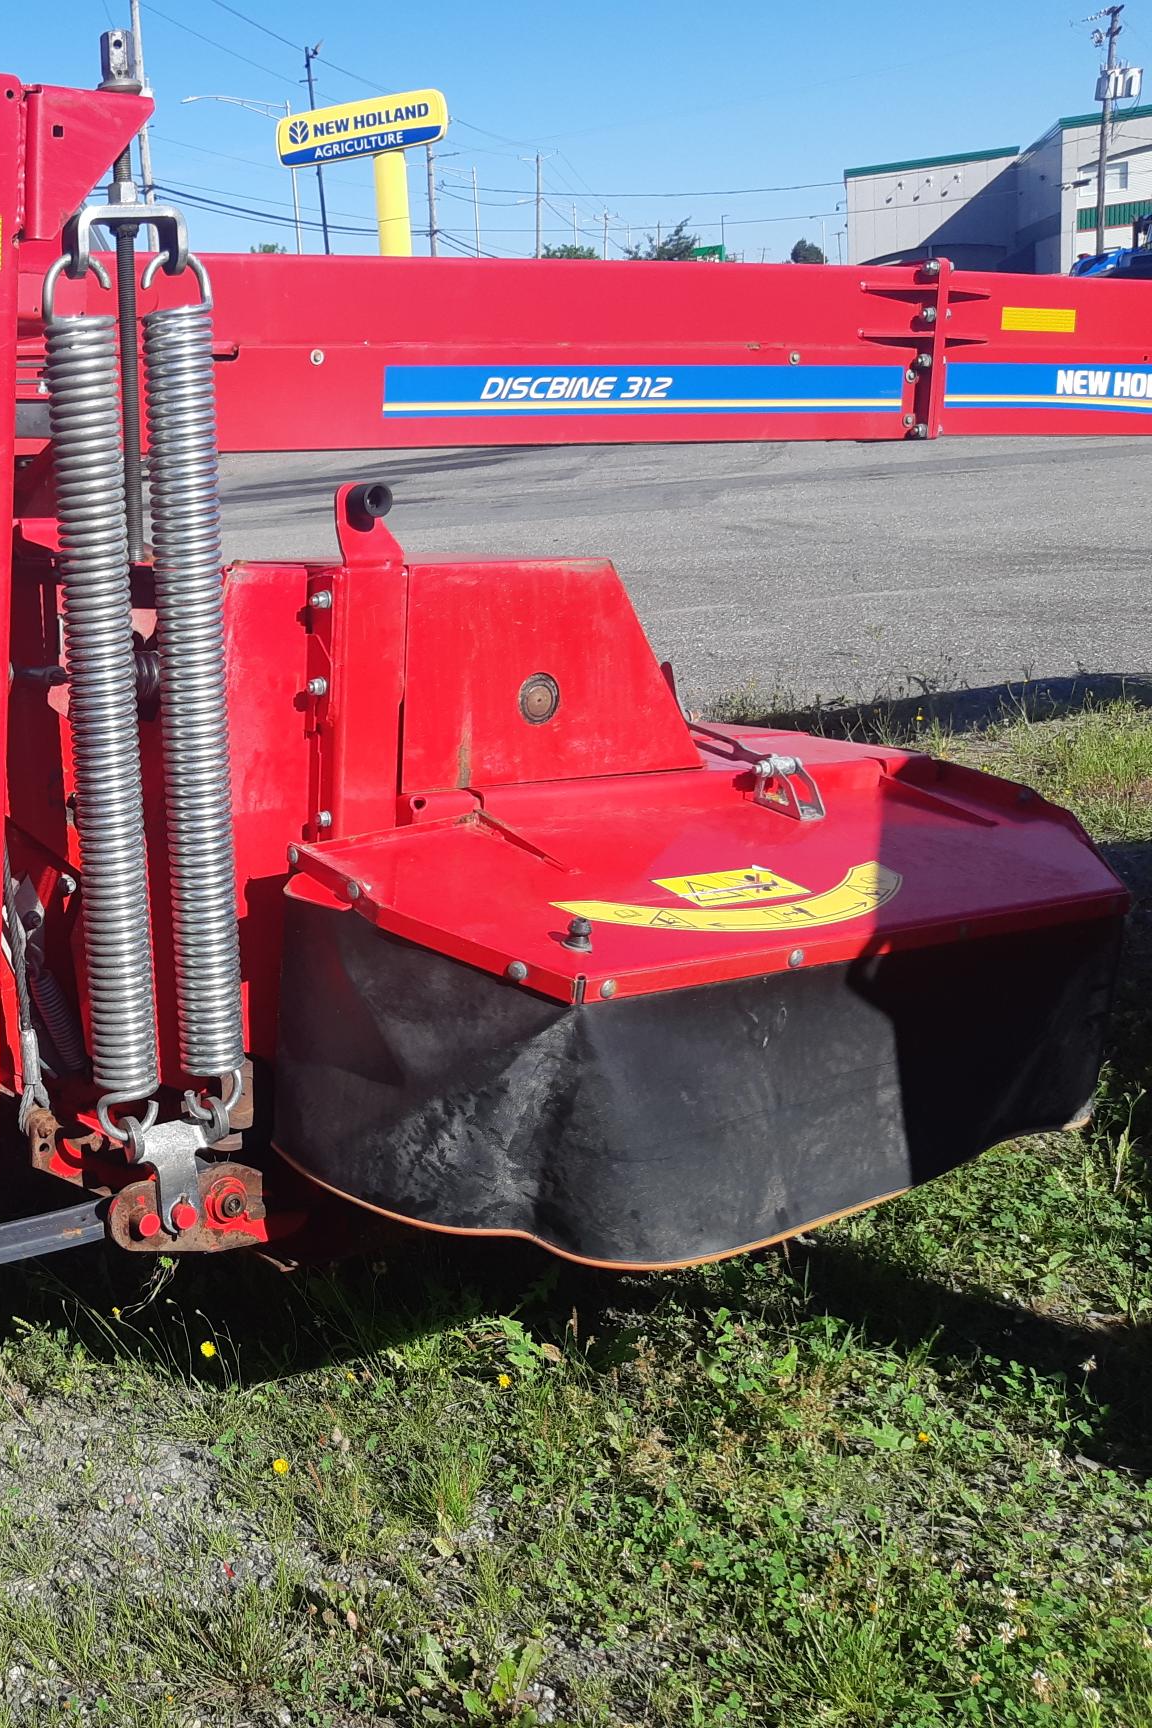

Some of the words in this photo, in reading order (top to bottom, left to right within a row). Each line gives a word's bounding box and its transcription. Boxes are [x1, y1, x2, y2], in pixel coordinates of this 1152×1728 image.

[313, 118, 350, 138] NEW
[353, 103, 430, 131] HOLLAND
[314, 131, 404, 159] AGRICULTURE
[480, 376, 618, 400] DISCBINE
[620, 376, 673, 399] 312
[1056, 369, 1111, 396] NEW
